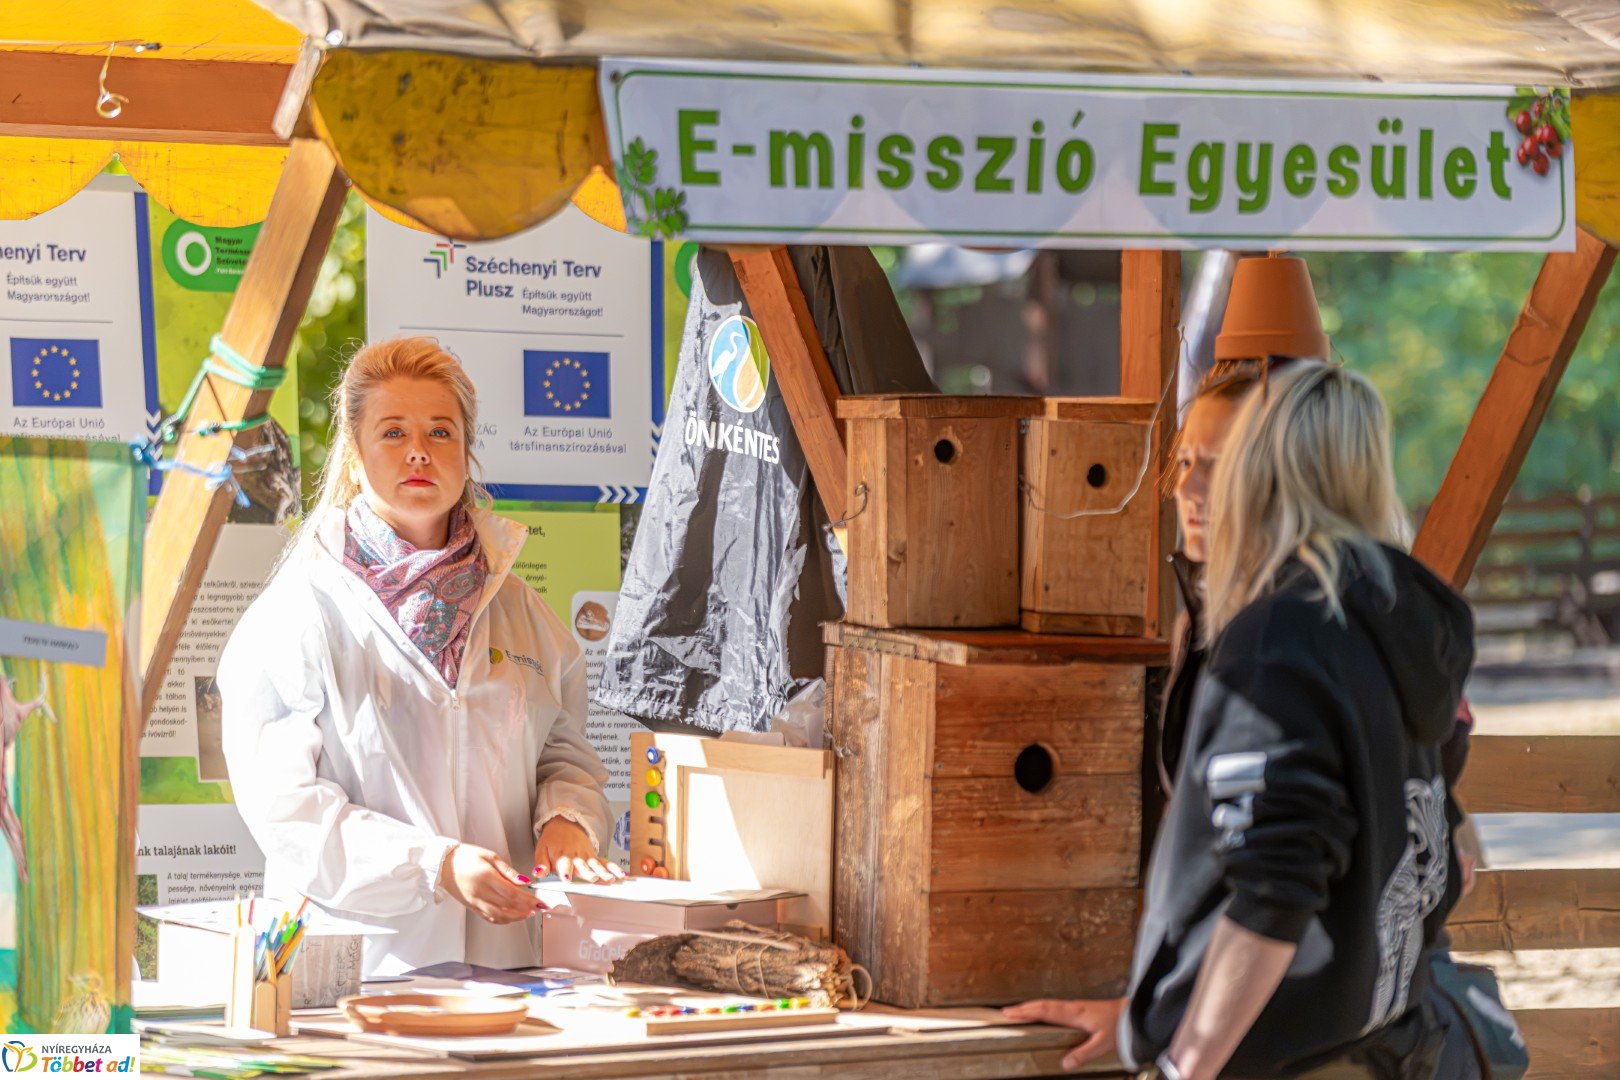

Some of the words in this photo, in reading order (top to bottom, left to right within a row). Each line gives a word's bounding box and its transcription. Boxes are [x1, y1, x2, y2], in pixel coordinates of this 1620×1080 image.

[677, 109, 1096, 195] E-misszió
[1138, 117, 1512, 214] Egyesület
[47, 244, 87, 262] Terv
[466, 256, 557, 278] Széchenyi
[563, 261, 602, 278] Terv
[7, 271, 42, 286] Építsük
[45, 276, 77, 289] együtt
[466, 280, 514, 298] Plusz
[522, 288, 558, 302] Építsük
[561, 291, 592, 303] együtt
[7, 290, 90, 304] Magyarországot!
[522, 304, 604, 318] Magyarországot!
[13, 417, 28, 428] Az
[32, 417, 76, 430] Európai
[80, 418, 105, 429] Unió
[524, 426, 538, 437] Az
[542, 426, 585, 439] Európai
[588, 427, 613, 439] Unió
[510, 441, 627, 455] társfinanszírozásával
[153, 845, 202, 859] talajának
[203, 844, 237, 856] lakóit!
